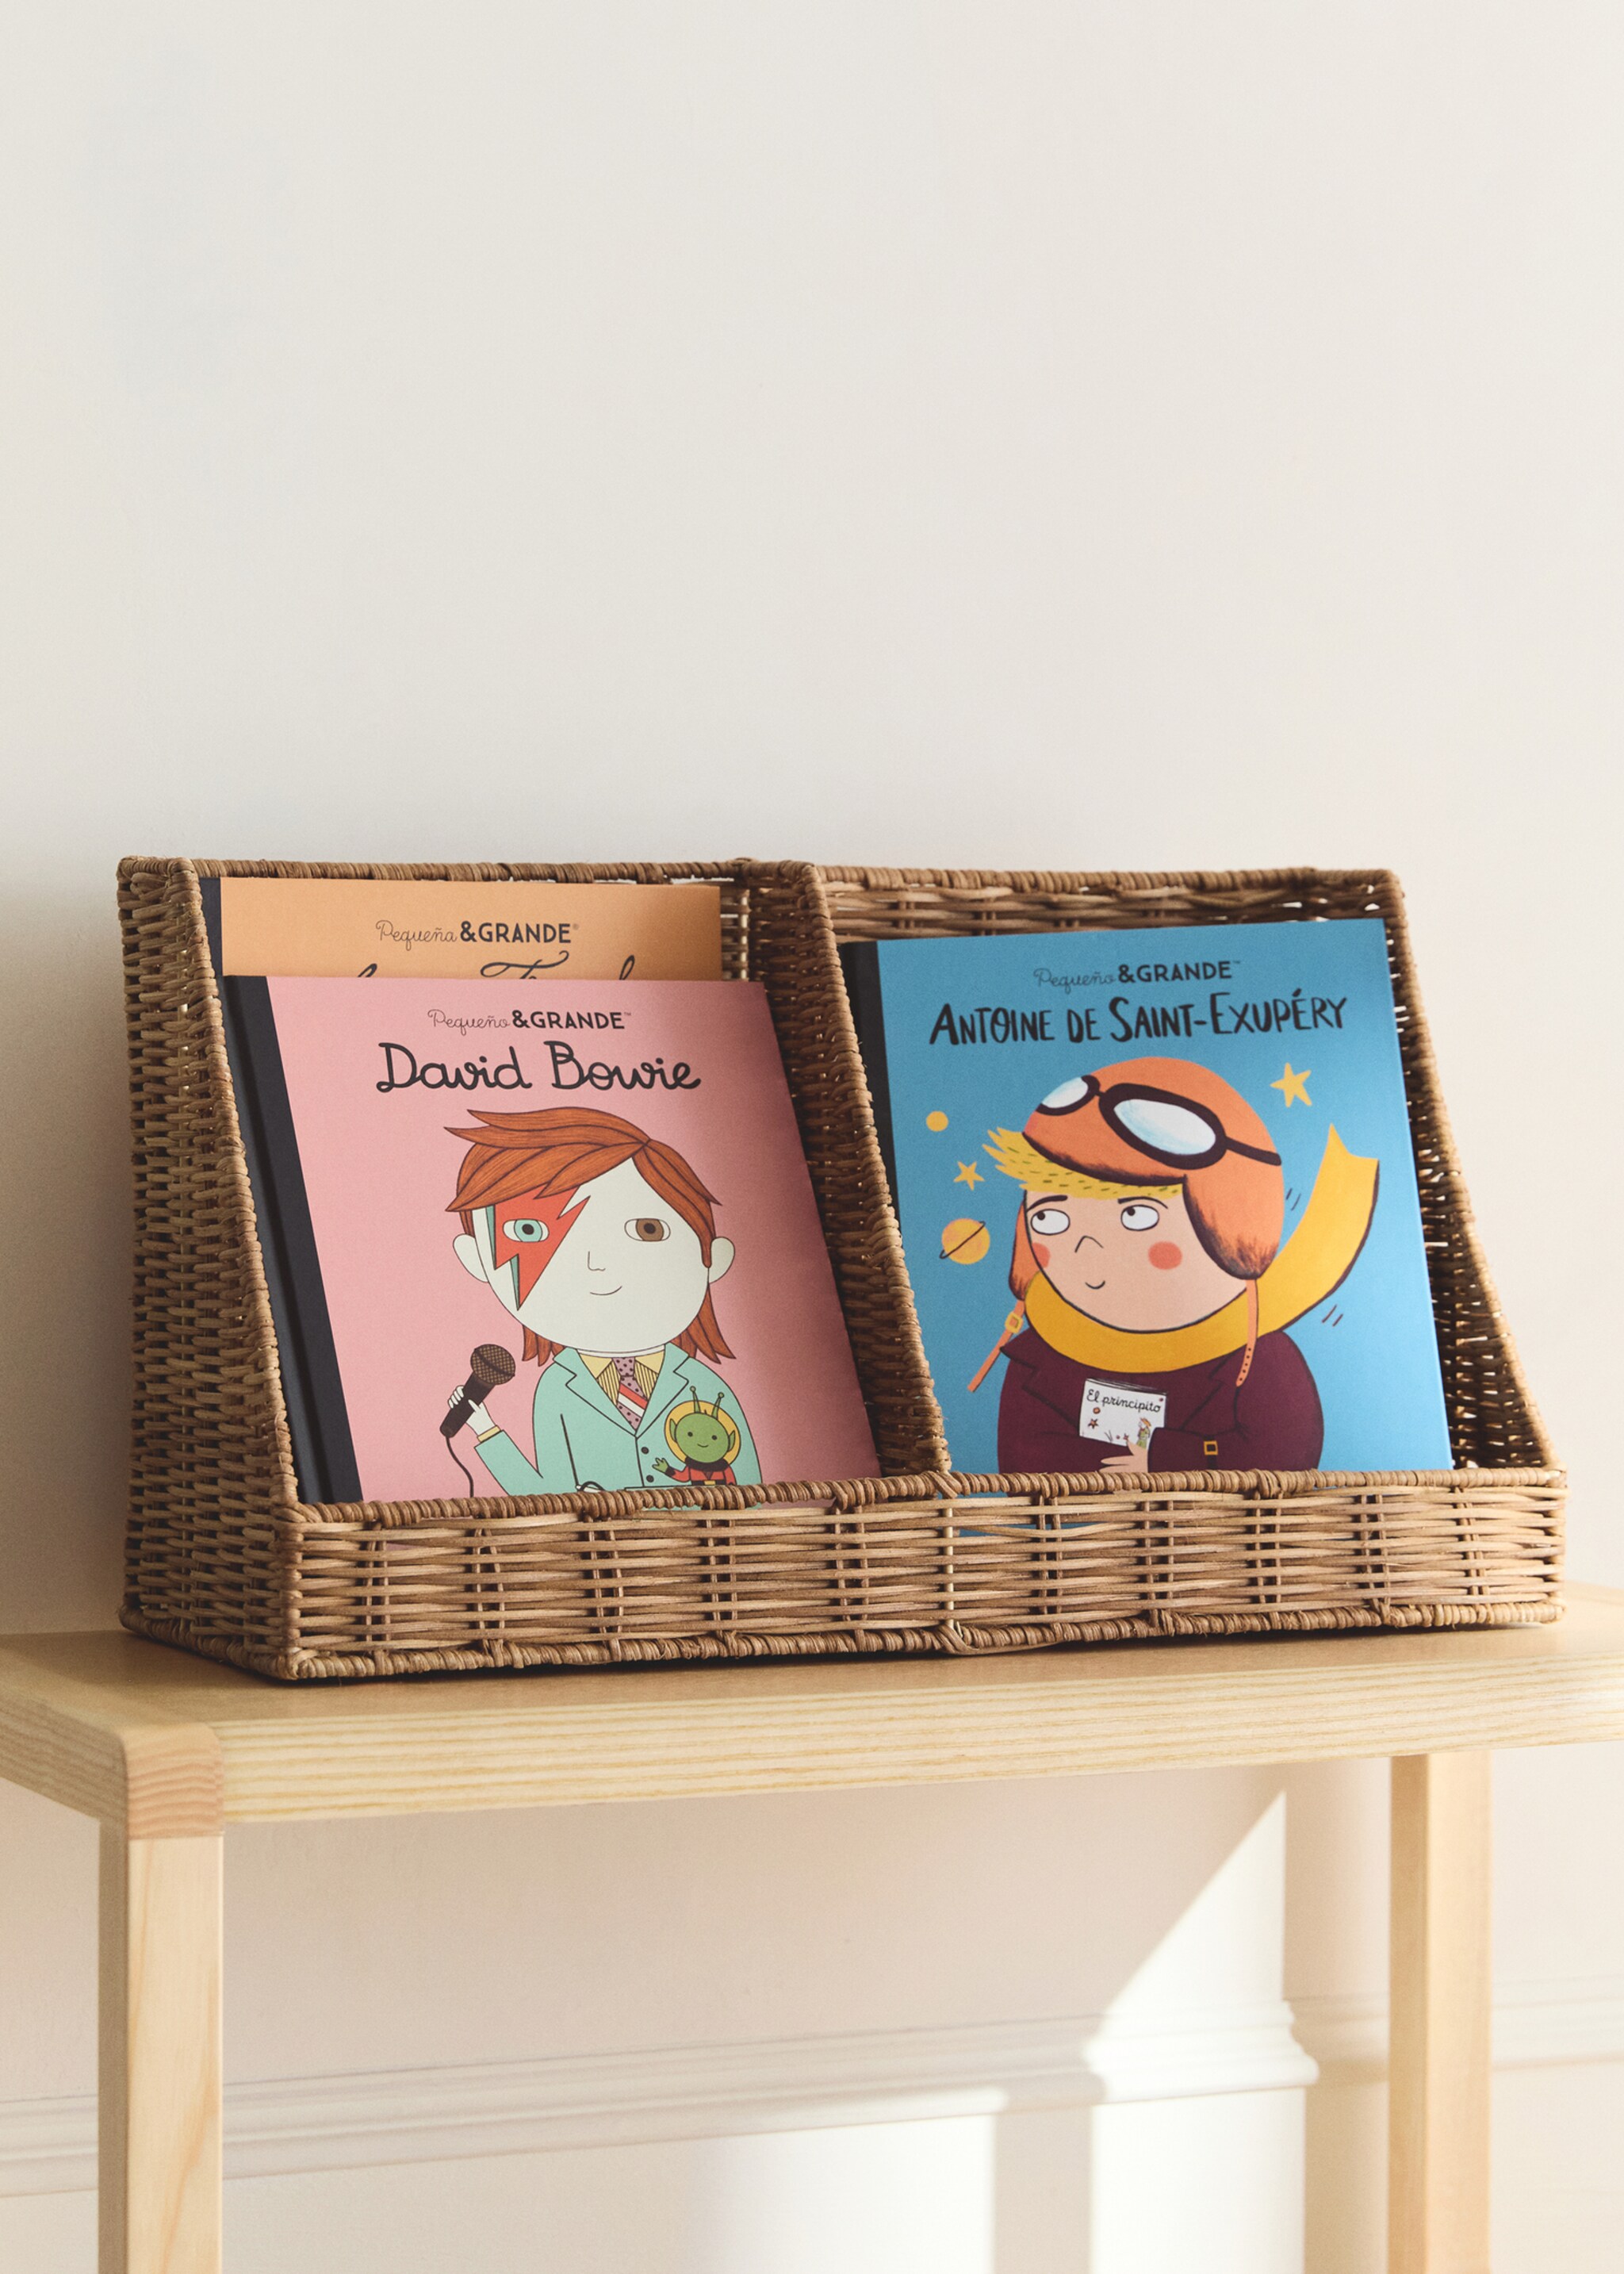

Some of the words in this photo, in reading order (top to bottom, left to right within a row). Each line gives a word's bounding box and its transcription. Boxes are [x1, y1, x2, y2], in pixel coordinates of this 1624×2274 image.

[376, 919, 458, 951] Pequeña
[1033, 968, 1113, 994] Pequeño
[427, 1009, 511, 1035] Pequeño
[929, 1003, 1055, 1045] ANTOINE
[1067, 1008, 1101, 1043] DE
[376, 1041, 532, 1093] David
[543, 1041, 701, 1091] Bowie
[1086, 1389, 1101, 1403] El
[1101, 1396, 1161, 1413] principito
